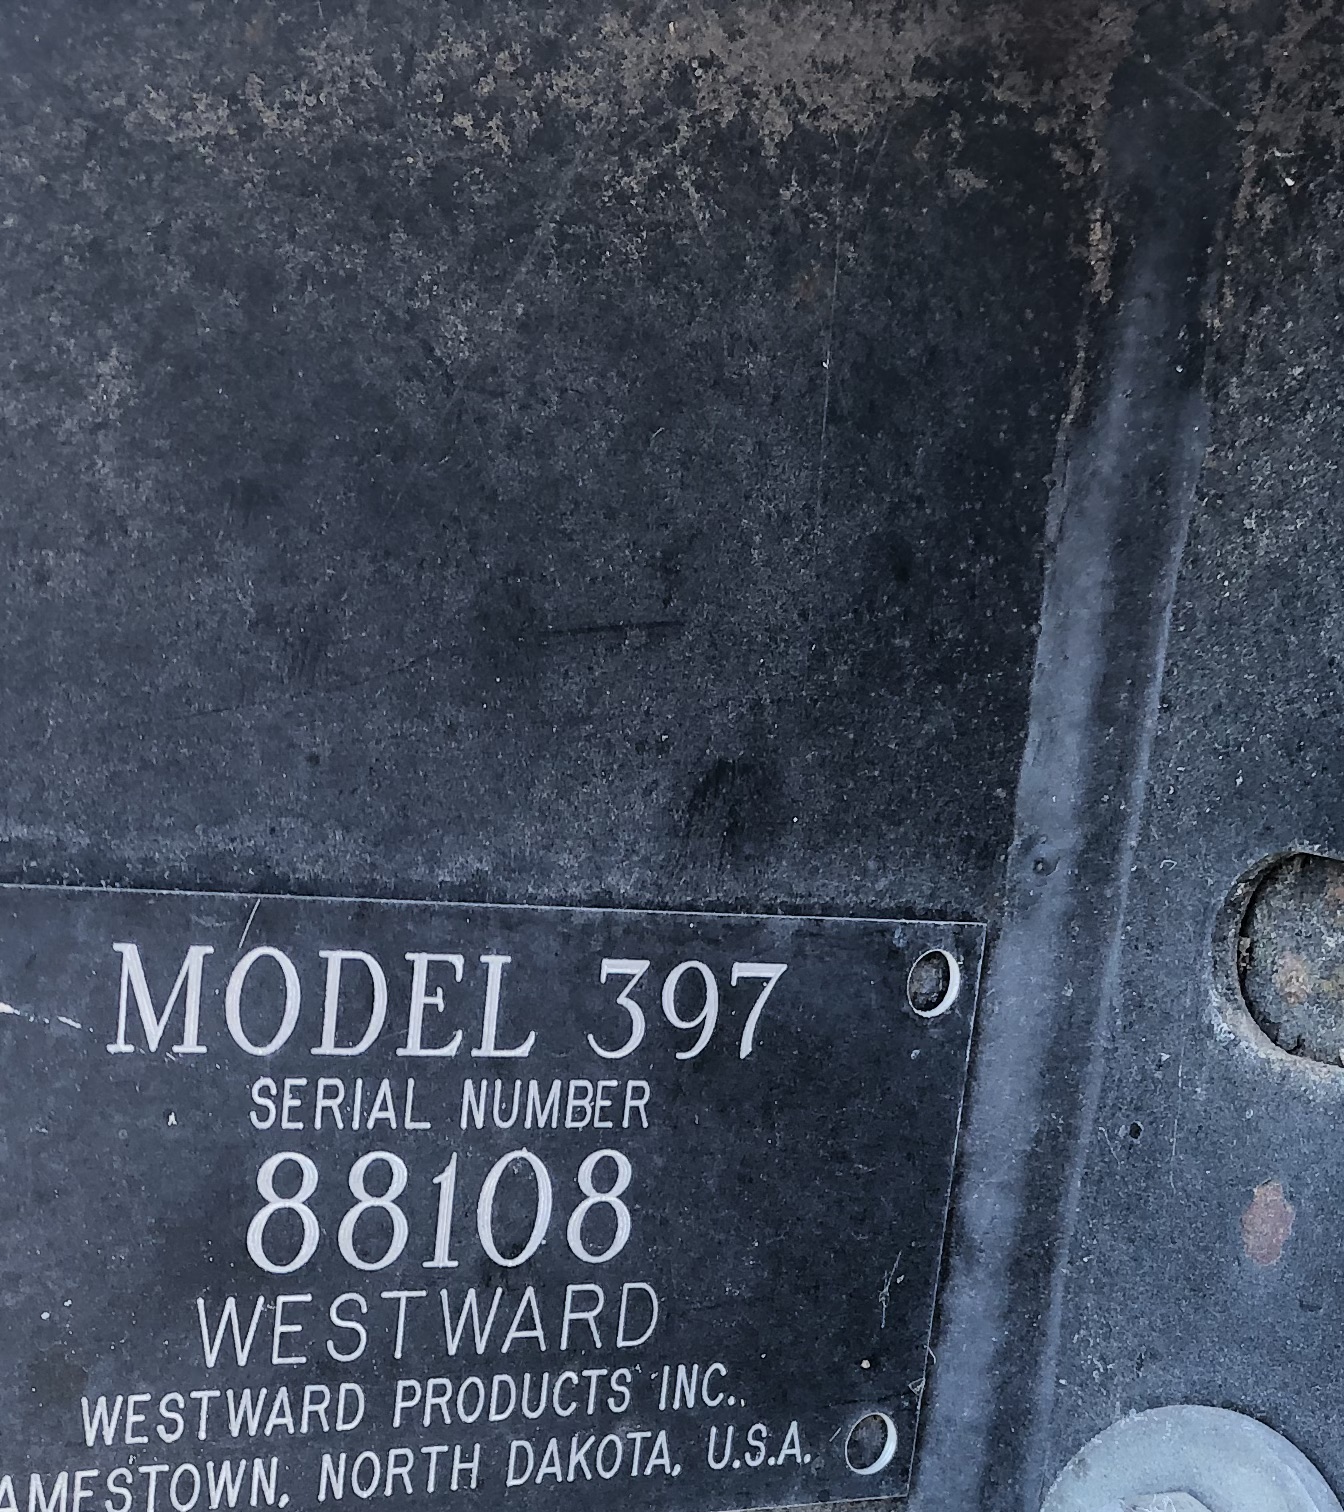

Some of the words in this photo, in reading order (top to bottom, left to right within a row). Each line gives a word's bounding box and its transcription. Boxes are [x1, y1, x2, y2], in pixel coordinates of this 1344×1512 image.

[106, 942, 536, 1058] MODEL
[587, 957, 788, 1060] 397
[249, 1075, 432, 1131] SERIAL
[460, 1078, 651, 1132] NUMBER
[246, 1146, 632, 1274] 88108
[196, 1282, 659, 1369] WESTWARD
[80, 1382, 365, 1447] WESTWARD
[392, 1367, 632, 1428] PRODUCTS
[317, 1442, 481, 1502] NORTH
[505, 1429, 681, 1488] DAKOTA,
[707, 1420, 812, 1470] U.S.A.
